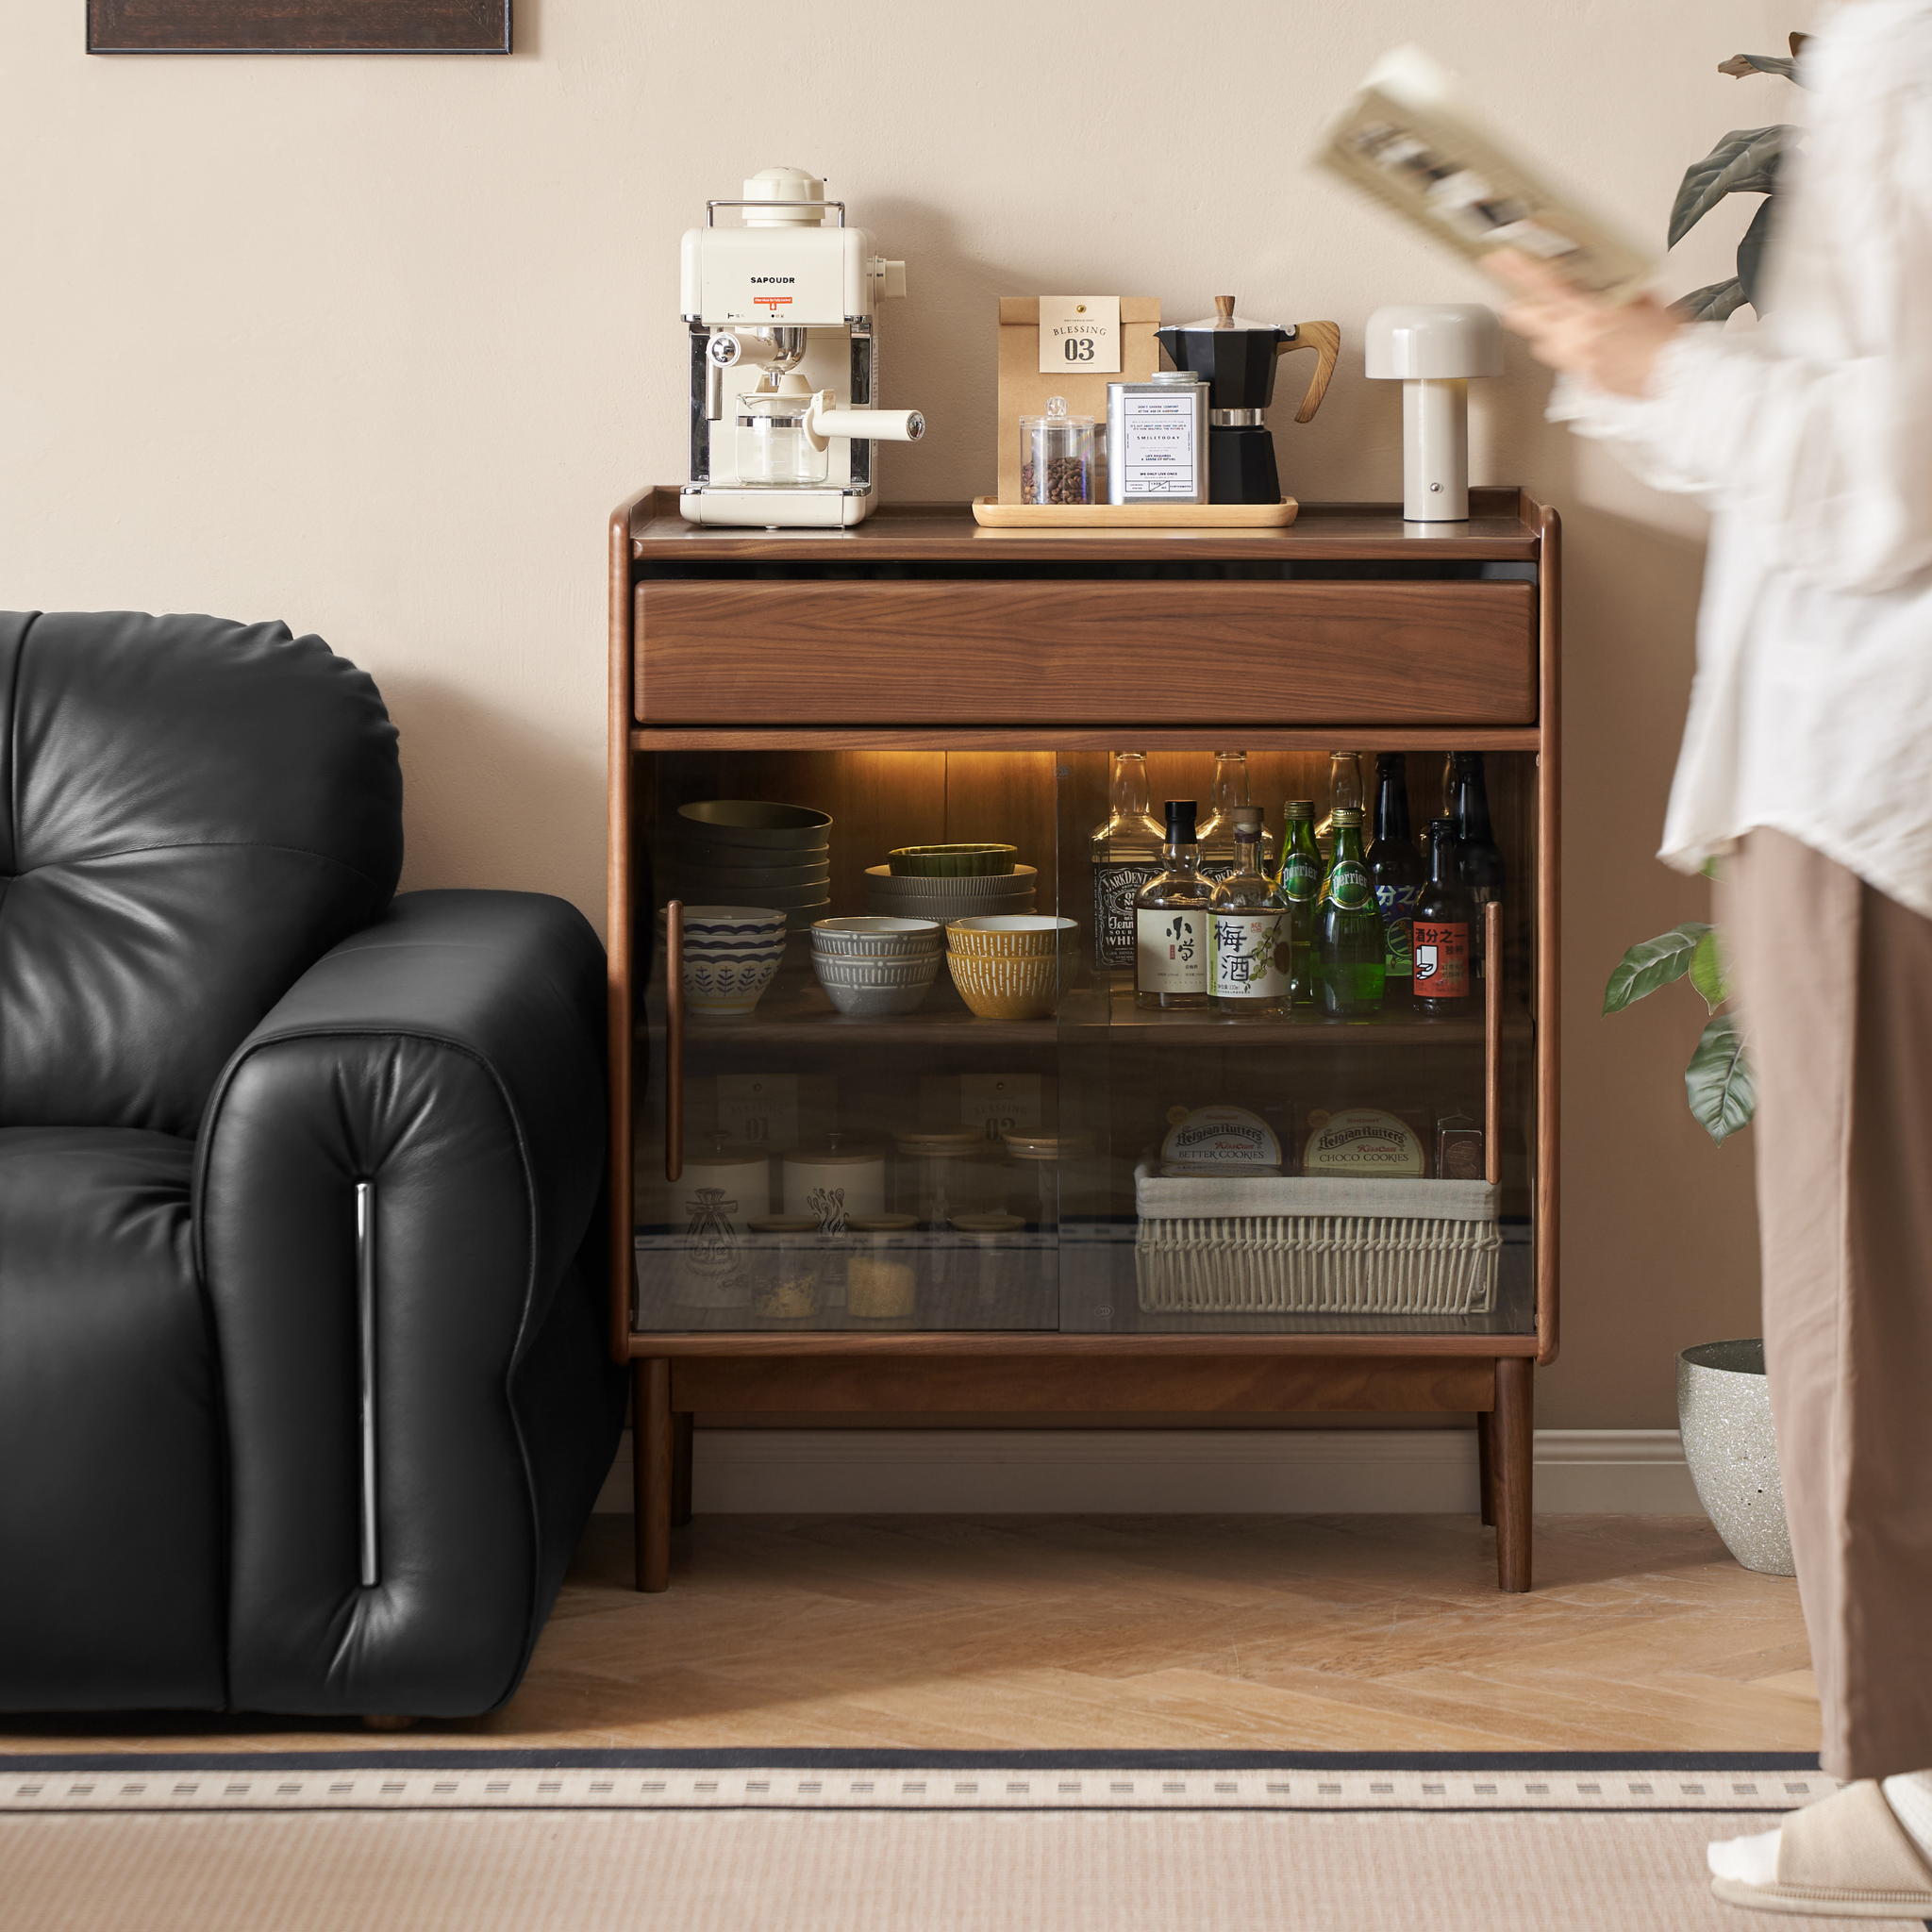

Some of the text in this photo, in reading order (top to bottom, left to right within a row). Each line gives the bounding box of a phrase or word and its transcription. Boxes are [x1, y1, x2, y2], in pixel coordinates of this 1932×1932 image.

[1053, 325, 1107, 336] BLESSING
[1064, 338, 1094, 361] 03
[1283, 862, 1318, 890] perrier
[1332, 870, 1368, 898] perrier
[1415, 927, 1466, 943] 酒分之一
[1213, 920, 1254, 981] 梅酒
[974, 1104, 1028, 1116] BLESSING
[745, 1117, 771, 1141] 01
[1178, 1150, 1264, 1160] BETTER COOKIES
[1319, 1153, 1409, 1163] CHOCO COOKIES
